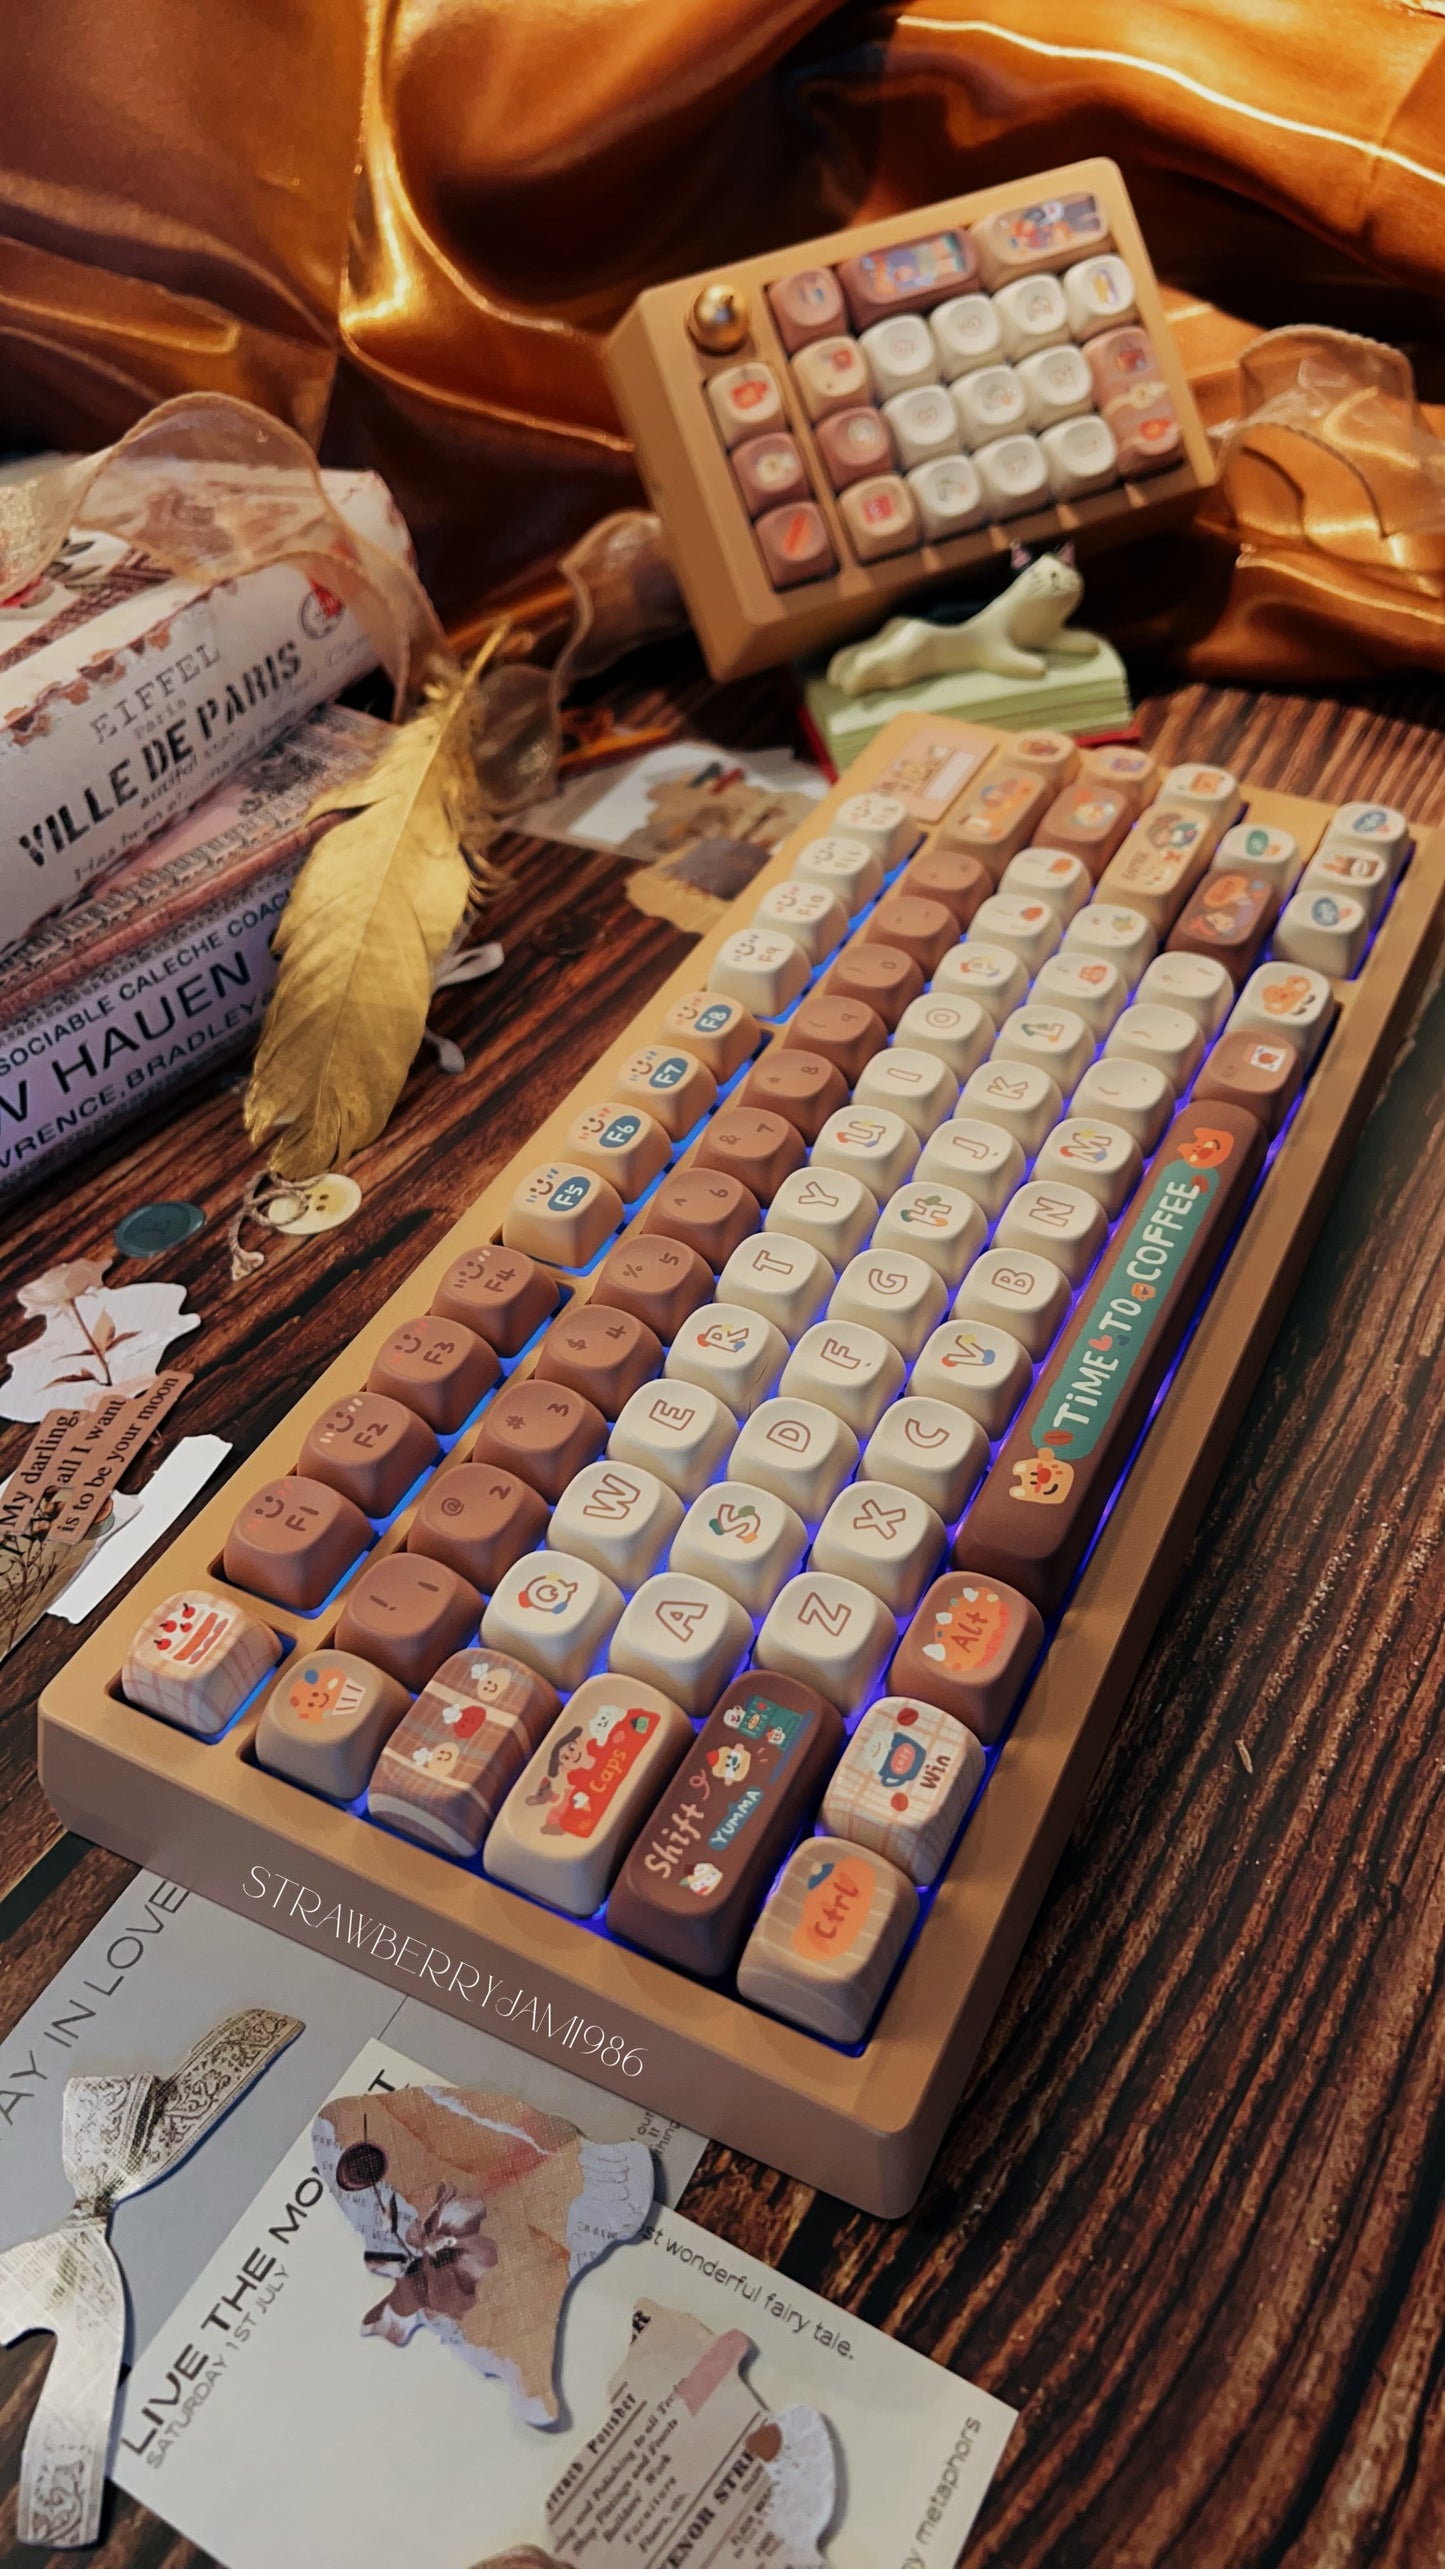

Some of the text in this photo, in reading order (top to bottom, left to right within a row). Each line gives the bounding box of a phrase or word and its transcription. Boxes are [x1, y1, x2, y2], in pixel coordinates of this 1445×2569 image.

[89, 641, 221, 744] EIFFEL
[19, 759, 139, 868] VILLE
[142, 719, 194, 782] DE
[197, 640, 302, 740] PARIS
[796, 894, 827, 916] F10
[118, 931, 224, 1002] CALECHE
[758, 945, 785, 964] F9
[51, 950, 251, 1095] HAUEN
[700, 1010, 727, 1029] F8
[125, 999, 259, 1090] BRADLEY
[655, 1063, 682, 1085] F7
[986, 1076, 1029, 1101] K
[606, 1123, 635, 1143] F6
[756, 1122, 775, 1135] 7
[952, 1135, 990, 1161] J
[1064, 1131, 1112, 1164] M
[554, 1183, 584, 1206] F5
[709, 1187, 729, 1199] 6
[798, 1181, 839, 1208] Y
[907, 1197, 952, 1226] H
[1028, 1196, 1075, 1228] N
[659, 1252, 680, 1267] 5
[752, 1249, 794, 1276] T
[1099, 1298, 1142, 1332] TO
[1126, 1181, 1200, 1282] COFFEE
[484, 1268, 517, 1293] F4
[868, 1268, 908, 1295] G
[991, 1267, 1035, 1296] B
[605, 1325, 626, 1340] 4
[704, 1324, 749, 1354] R
[423, 1341, 455, 1366] F3
[819, 1337, 862, 1371] F
[946, 1334, 991, 1367] V
[547, 1402, 570, 1417] 3
[649, 1398, 696, 1432] E
[57, 1453, 83, 1484] all
[85, 1399, 127, 1441] want
[352, 1421, 389, 1449] F2
[765, 1419, 812, 1454] D
[904, 1418, 950, 1449] C
[1, 1410, 81, 1528] My darling,
[57, 1376, 180, 1534] is to be your moon
[489, 1484, 513, 1500] 2
[582, 1472, 641, 1521] W
[285, 1505, 320, 1532] F1
[717, 1503, 762, 1540] S
[853, 1498, 907, 1541] X
[524, 1574, 579, 1613] Q
[655, 1600, 709, 1643] A
[798, 1591, 852, 1638] Z
[951, 1610, 990, 1652] Alt
[588, 1749, 627, 1794] Caps
[920, 1754, 951, 1790] Win
[644, 1801, 706, 1879] Shift
[814, 1874, 860, 1942] Ctrl
[43, 1999, 97, 2048] IN
[83, 1879, 190, 1996] LOVE
[666, 2237, 762, 2304] wonderful
[764, 2293, 812, 2333] fairy
[814, 2322, 855, 2360] tale.
[120, 2343, 209, 2455] LIVE
[200, 2247, 277, 2331] THE
[146, 2264, 289, 2469] SATURDAY 1ST JULY
[915, 2417, 982, 2545] metaphors
